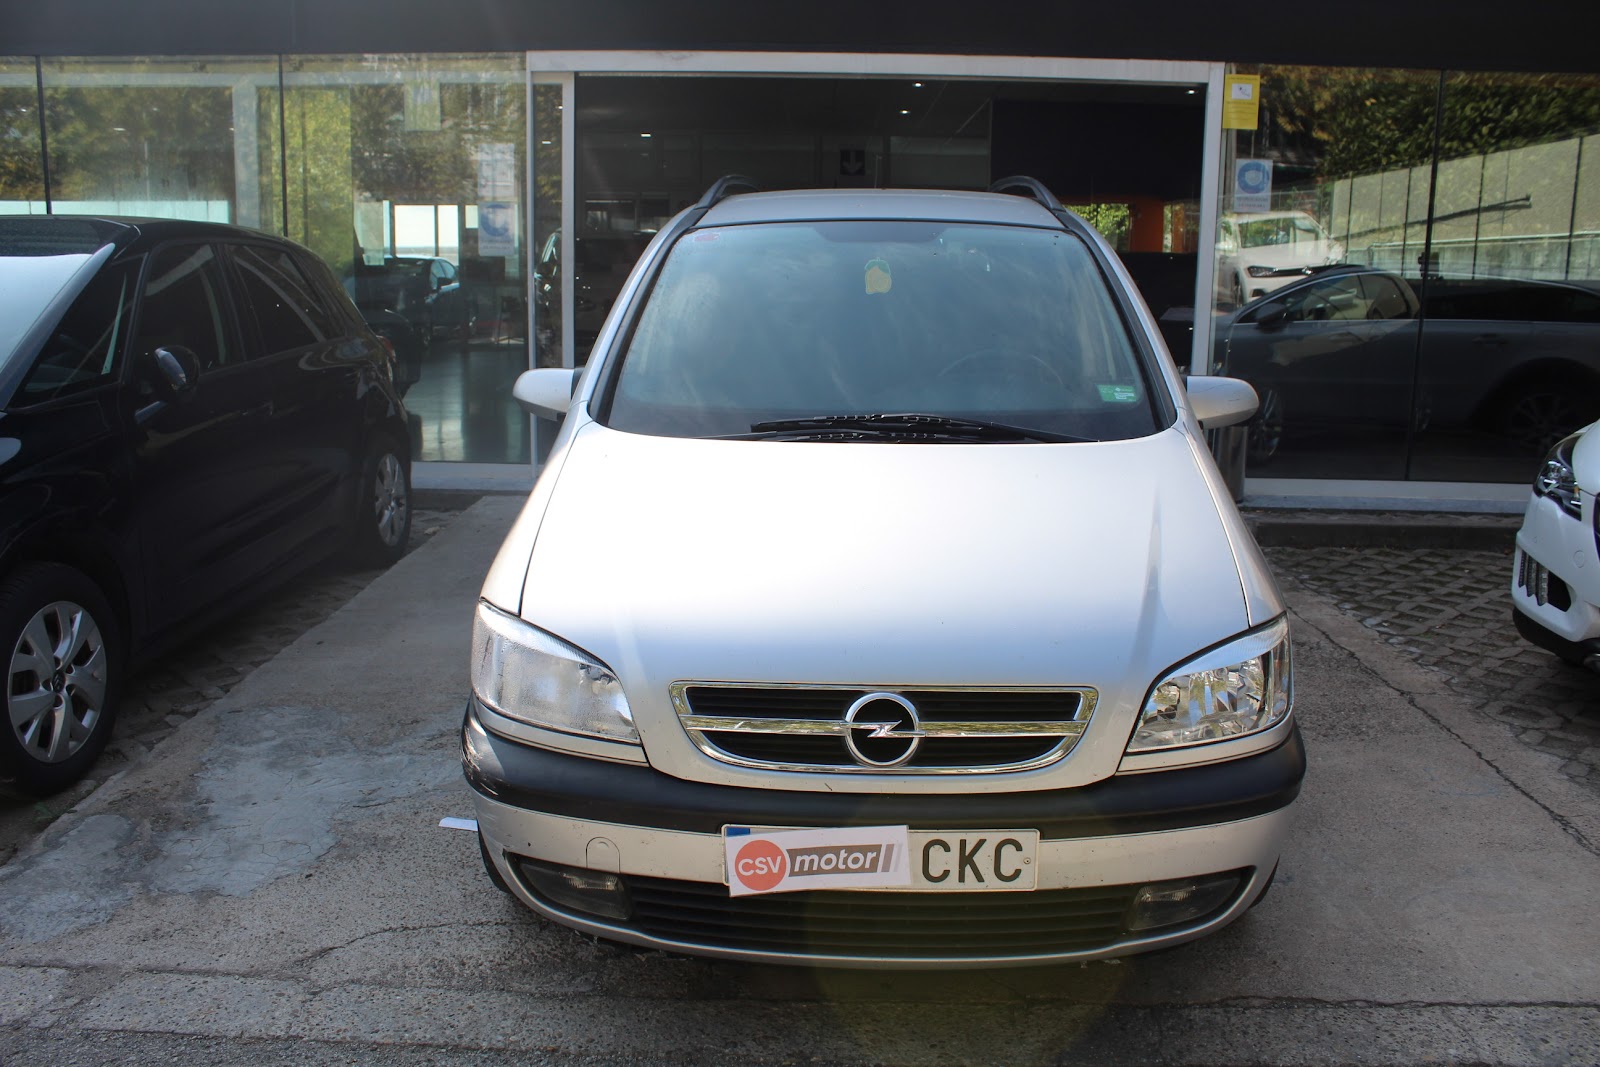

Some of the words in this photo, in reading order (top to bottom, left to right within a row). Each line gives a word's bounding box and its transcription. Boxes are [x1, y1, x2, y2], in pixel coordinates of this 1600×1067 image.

[738, 856, 781, 876] CSV
[794, 849, 877, 872] motor
[922, 838, 1023, 883] CKC
